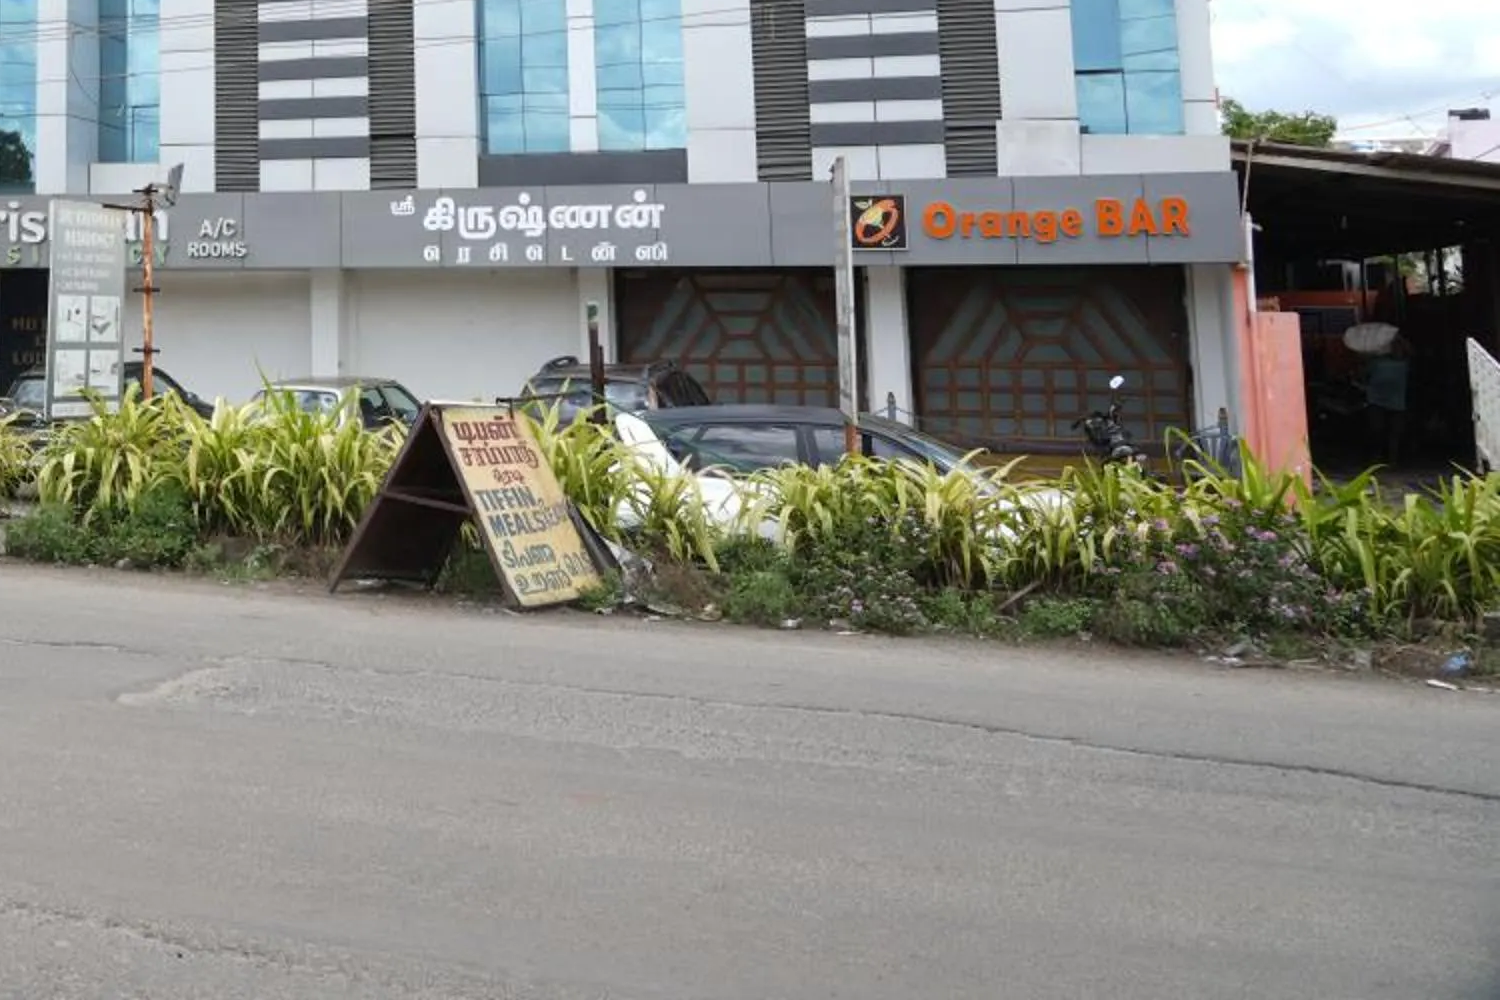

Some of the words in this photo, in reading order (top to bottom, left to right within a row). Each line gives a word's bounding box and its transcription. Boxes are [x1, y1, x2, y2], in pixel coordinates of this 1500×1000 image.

[200, 217, 236, 239] A/C
[423, 189, 665, 239] கிருஷ்ணன்
[922, 200, 1084, 244] Orange
[1094, 196, 1191, 238] BAR
[187, 240, 248, 258] ROOMS
[487, 509, 546, 538] MEALS
